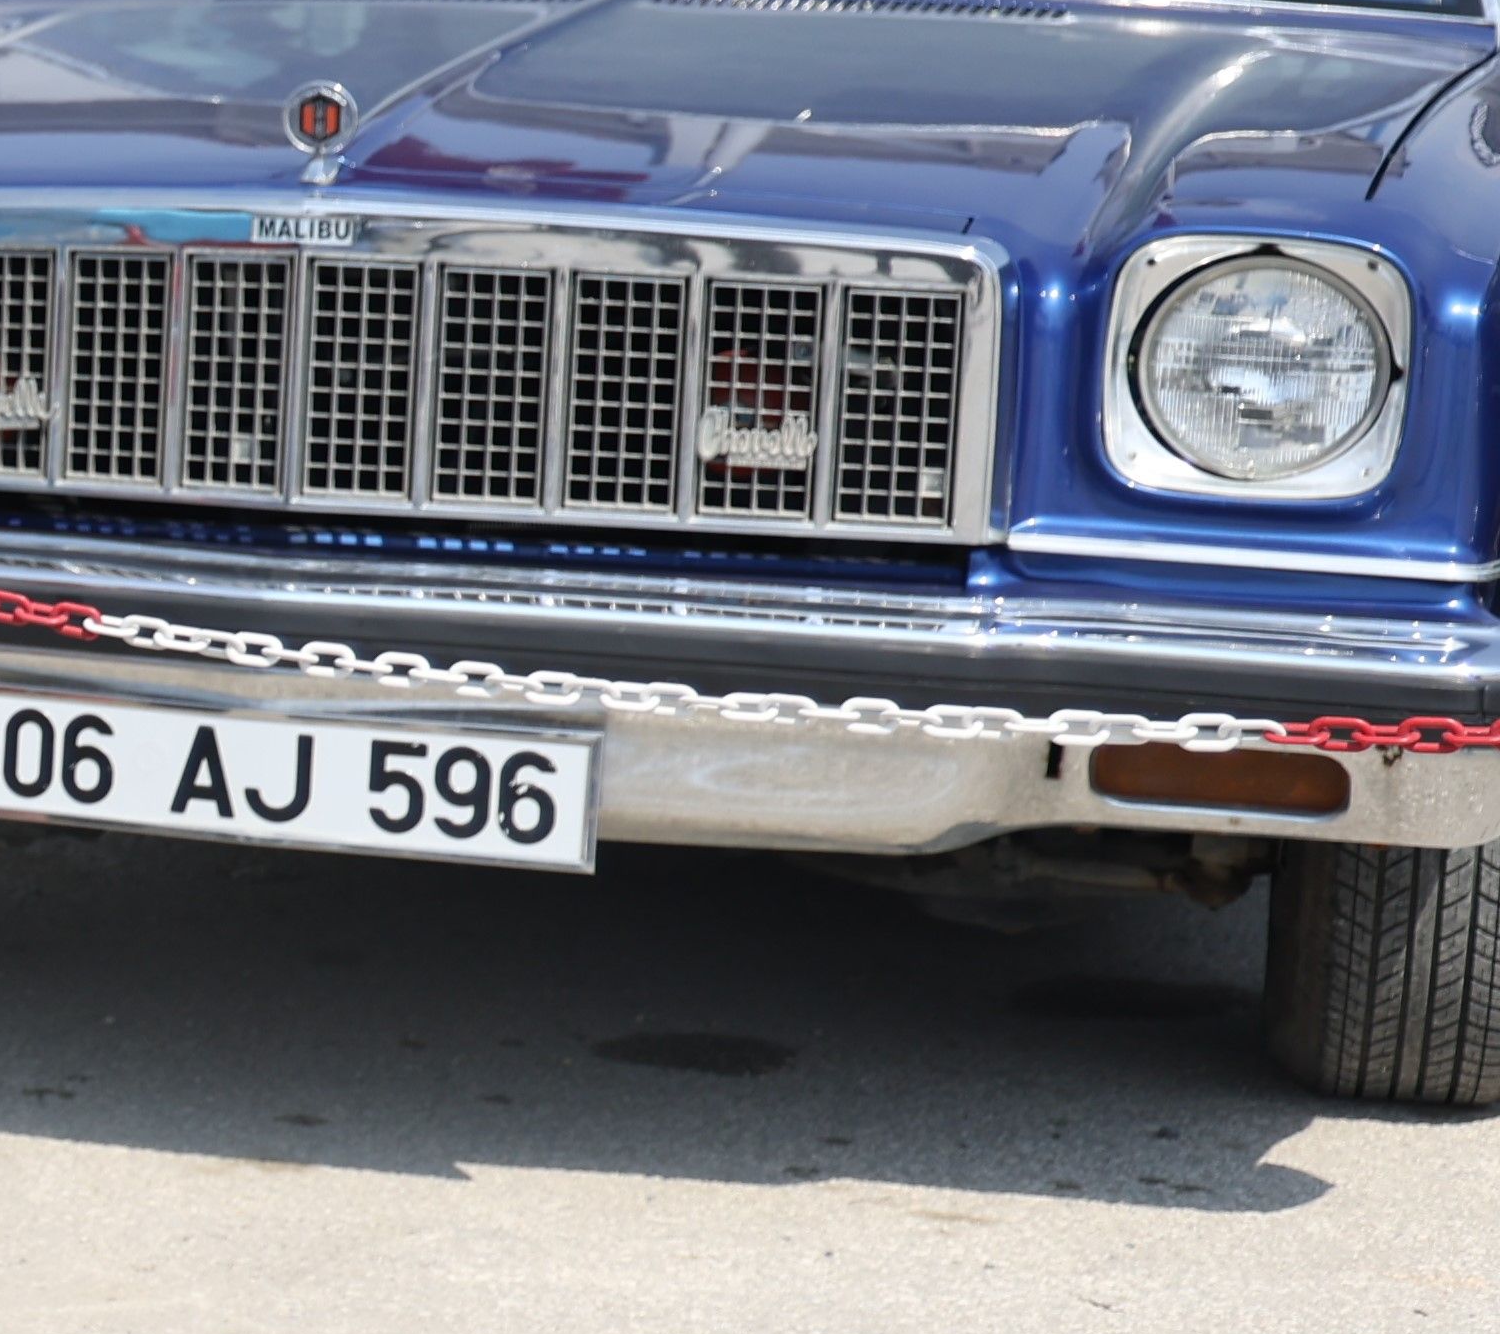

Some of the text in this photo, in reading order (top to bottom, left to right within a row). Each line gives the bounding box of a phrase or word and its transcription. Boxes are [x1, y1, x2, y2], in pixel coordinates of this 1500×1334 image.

[258, 217, 350, 241] MALIBU
[3, 708, 558, 845] 06 AJ 596
